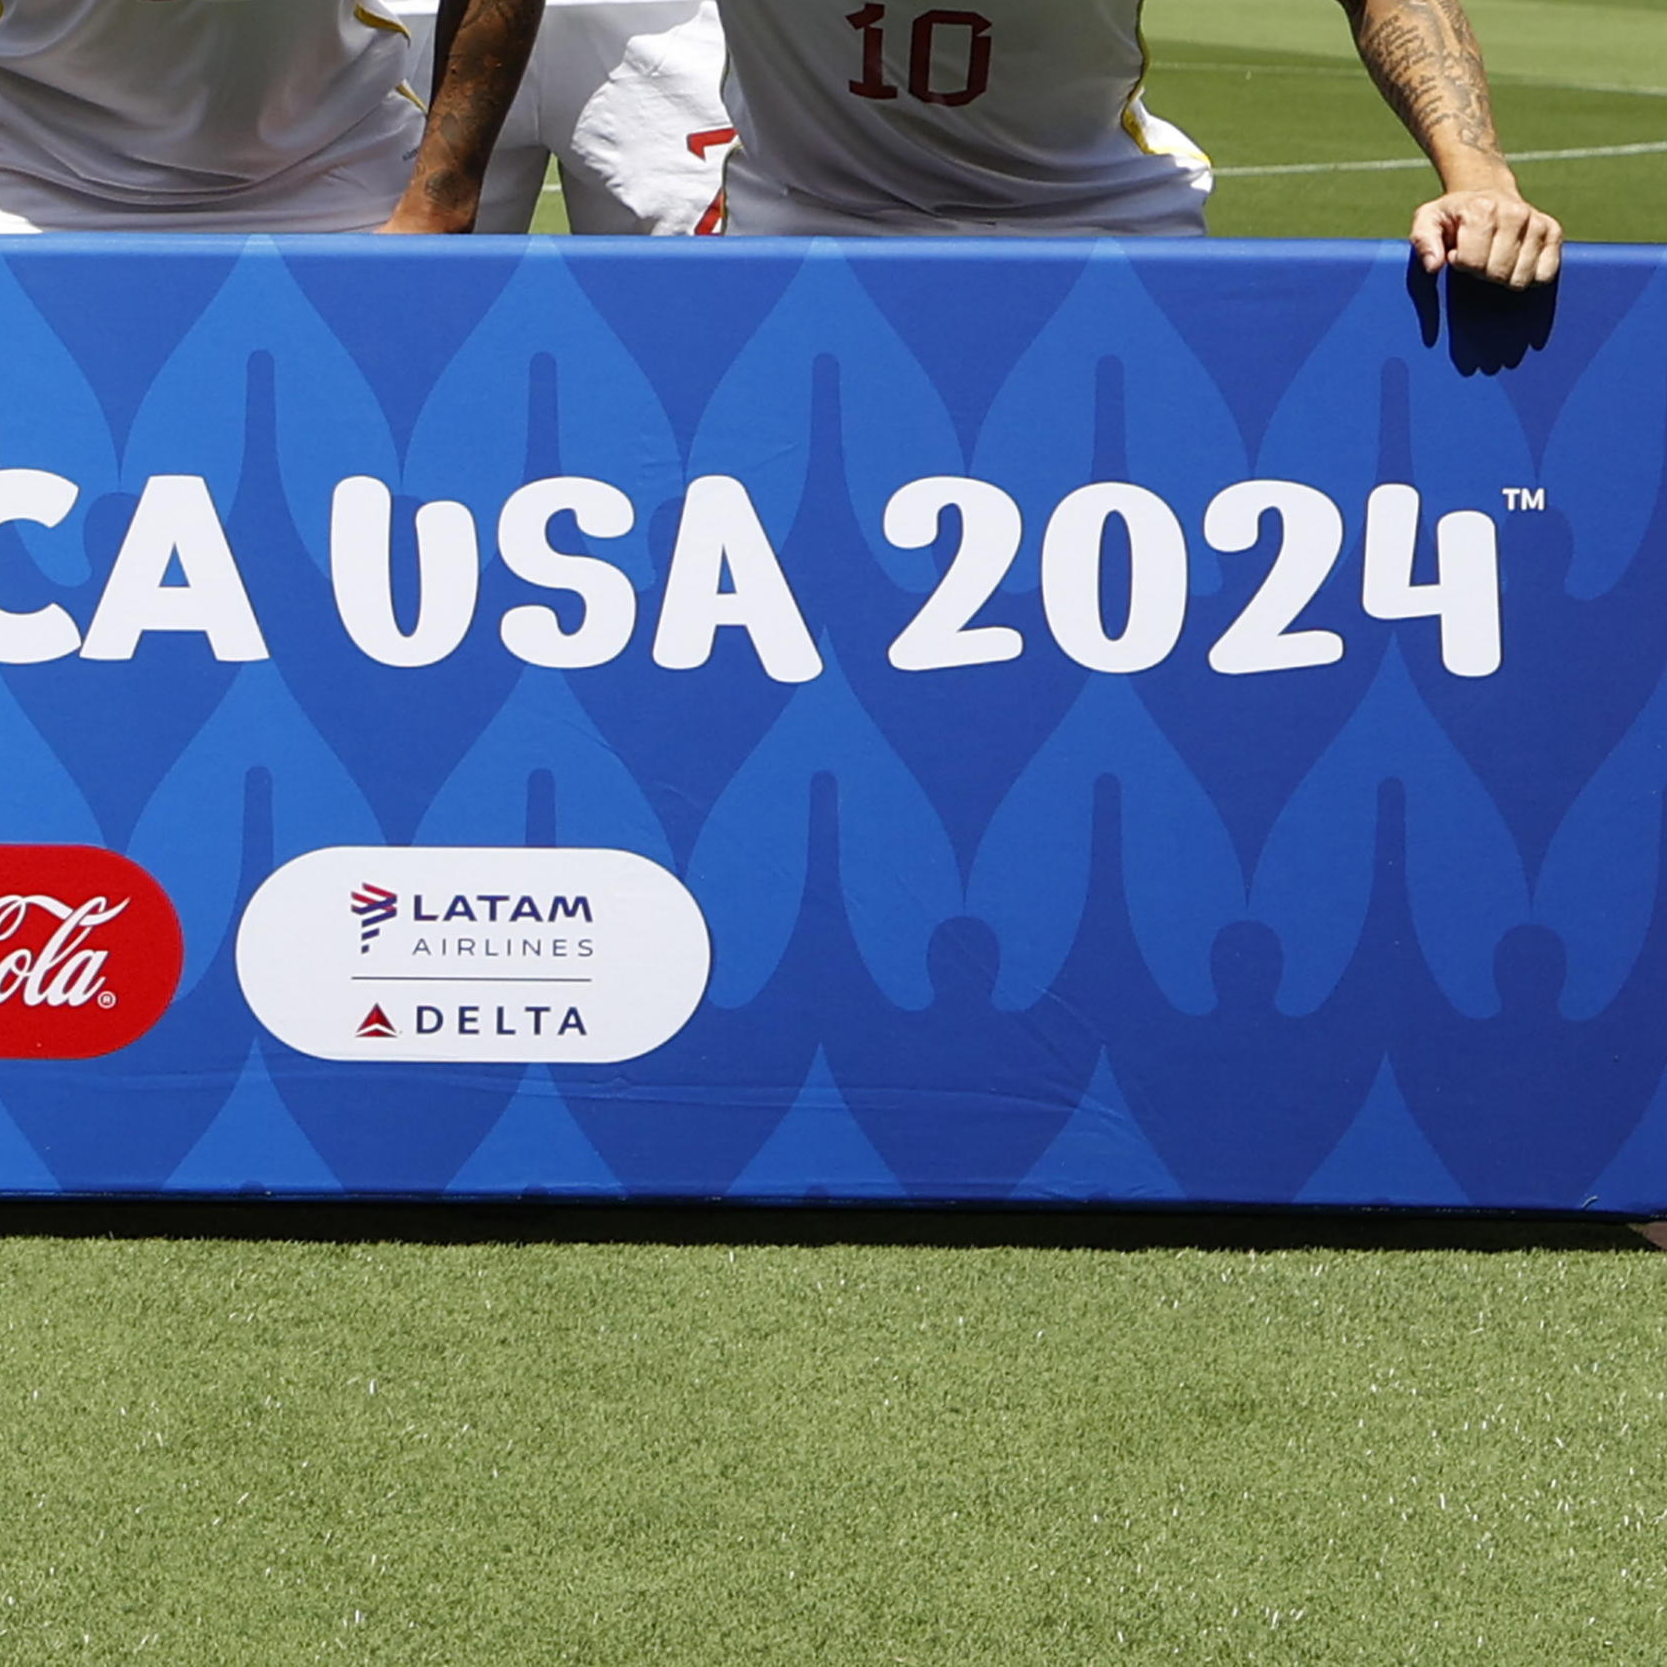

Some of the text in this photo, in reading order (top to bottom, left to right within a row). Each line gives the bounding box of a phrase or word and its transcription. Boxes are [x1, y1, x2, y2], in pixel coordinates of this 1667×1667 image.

[846, 1, 993, 108] 10
[329, 475, 824, 683] USA
[413, 894, 594, 923] LATAM
[412, 937, 594, 958] AIRLINES
[415, 1005, 588, 1036] DELTA
